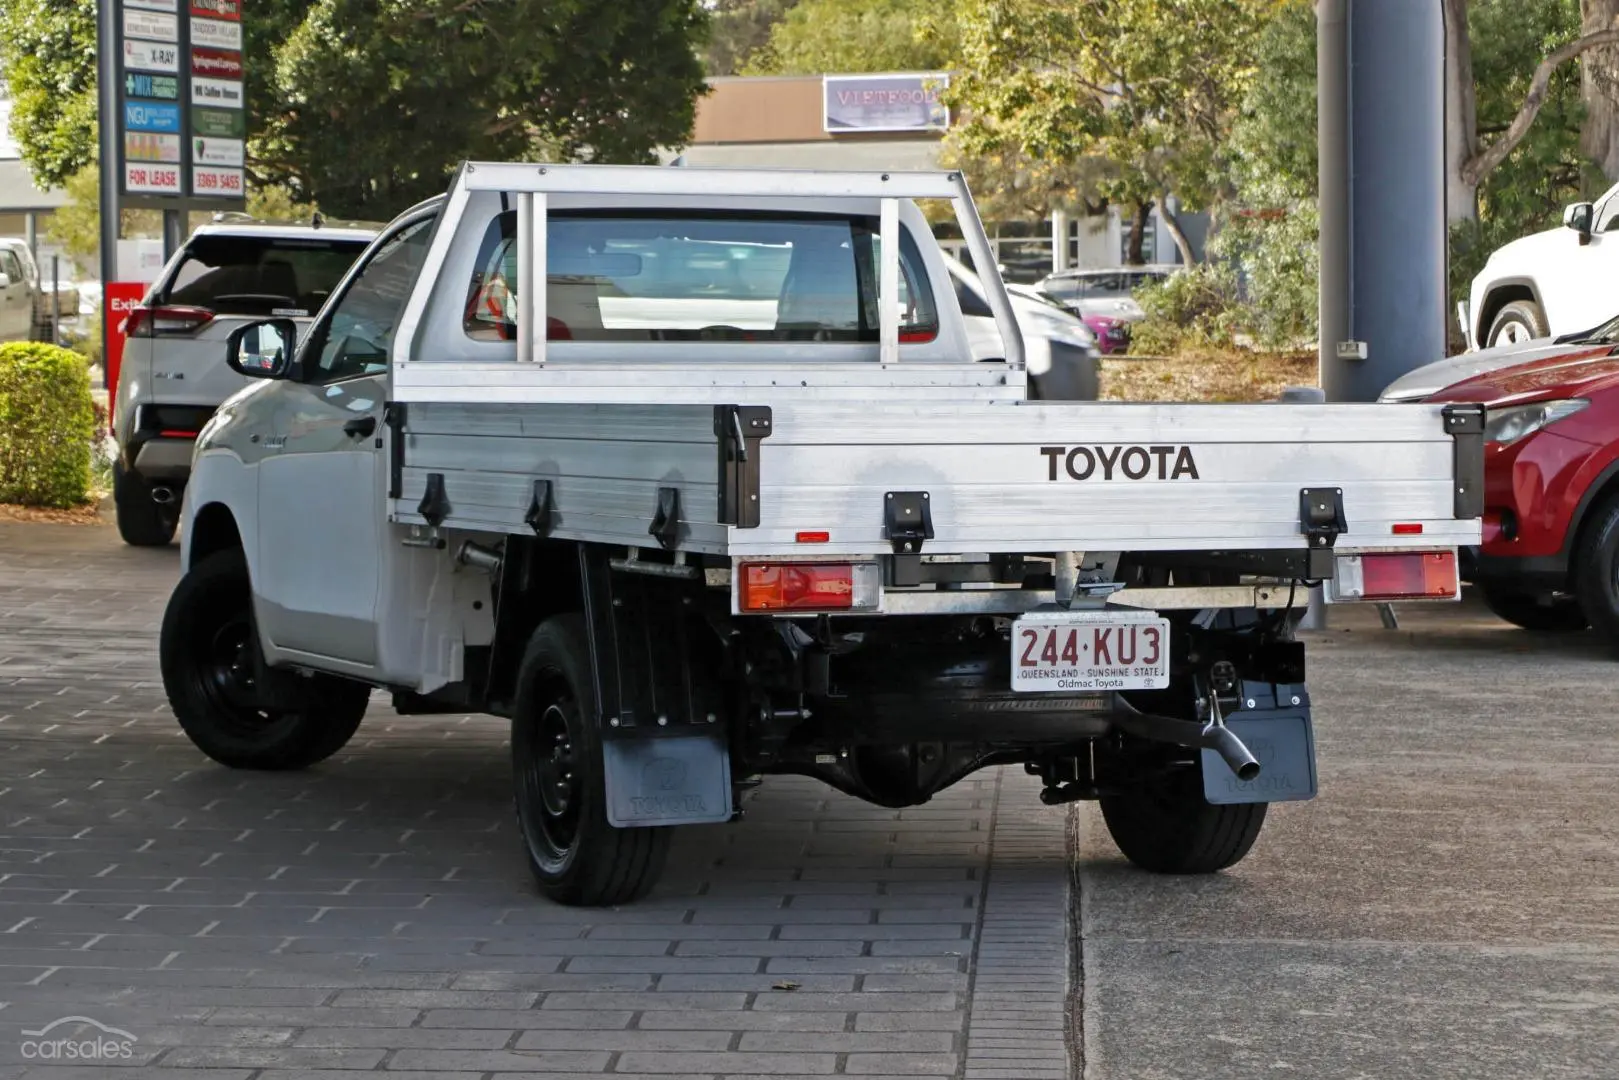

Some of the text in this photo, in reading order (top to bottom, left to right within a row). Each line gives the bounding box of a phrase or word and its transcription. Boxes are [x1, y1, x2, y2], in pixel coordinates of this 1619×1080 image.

[151, 49, 175, 65] X-RAY
[127, 106, 147, 125] NGU
[129, 169, 176, 187] FOR LEASE
[197, 172, 217, 188] 3369
[1040, 445, 1200, 481] TOYOTA
[1021, 669, 1079, 680] QUEENSLAND
[1087, 668, 1129, 678] SUNSHINE
[1134, 667, 1159, 677] STATE
[1057, 678, 1124, 689] Oldmac Toyota
[629, 794, 708, 816] TOYOTA
